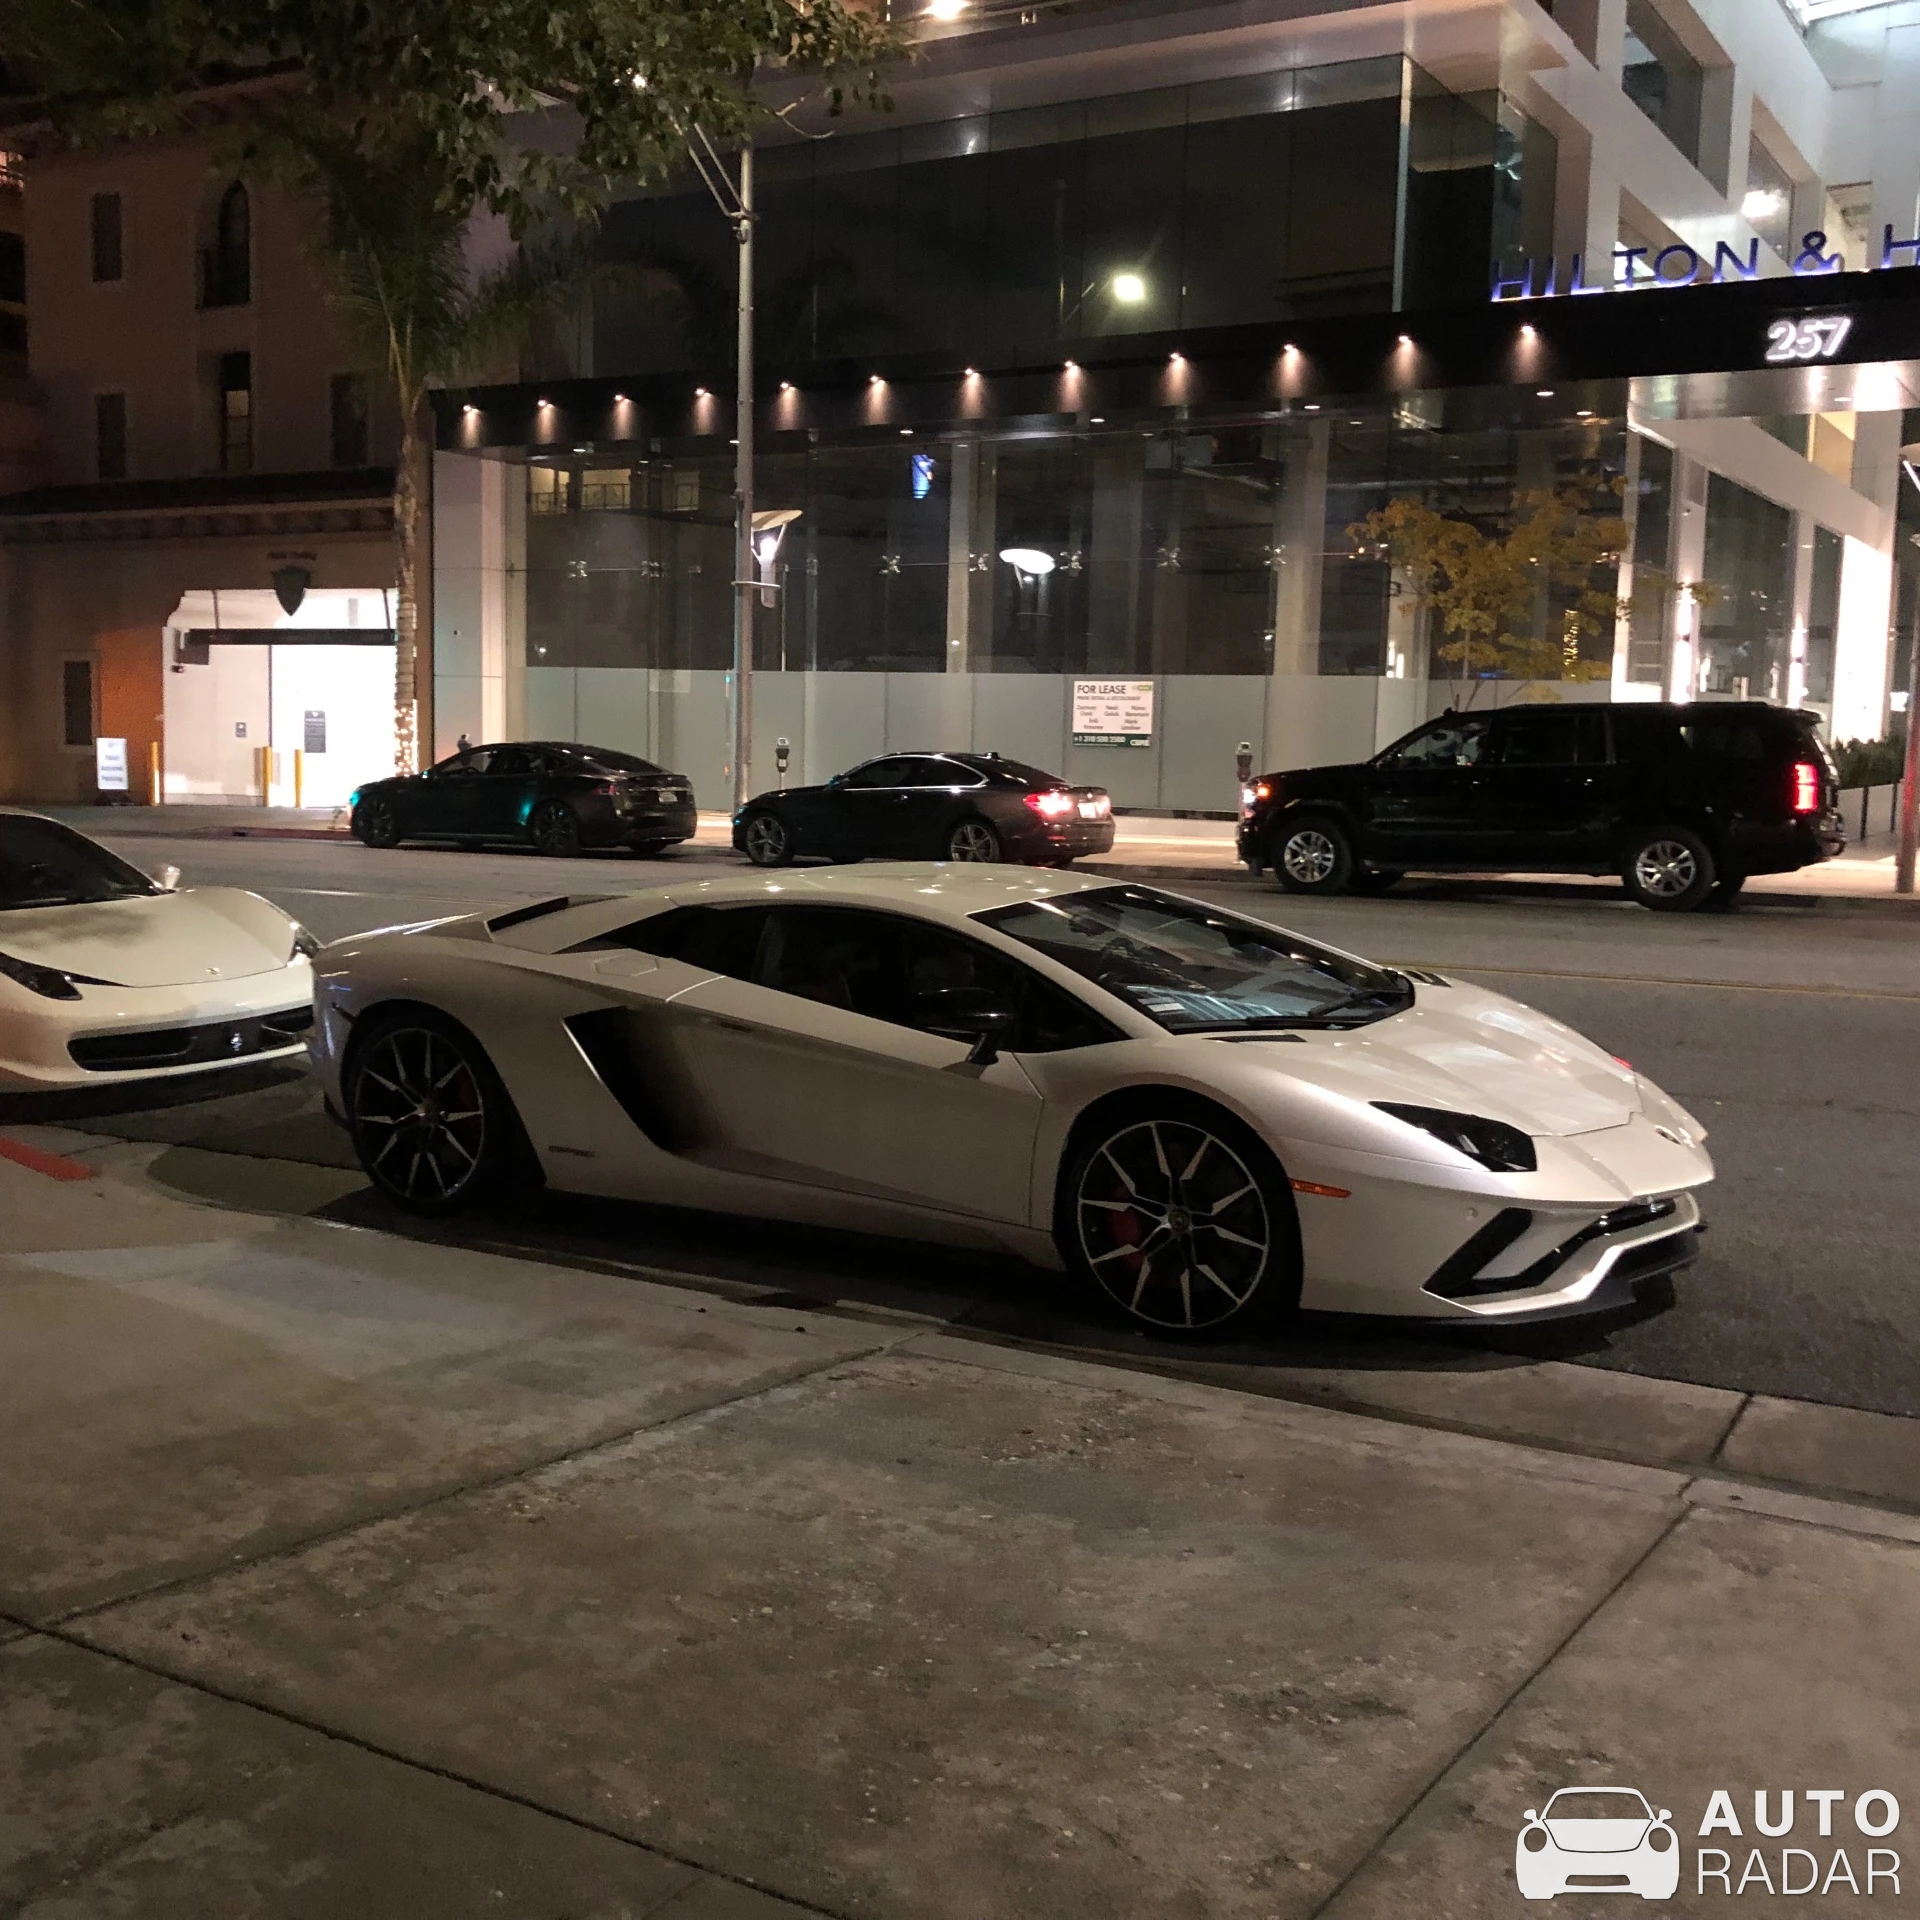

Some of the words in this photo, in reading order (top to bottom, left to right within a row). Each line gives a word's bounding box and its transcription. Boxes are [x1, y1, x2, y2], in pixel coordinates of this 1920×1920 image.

[1491, 238, 1759, 301] HILTON
[1793, 231, 1843, 276] &
[1765, 316, 1851, 361] 257
[1077, 685, 1096, 694] FOR
[1098, 685, 1127, 694] LEASE
